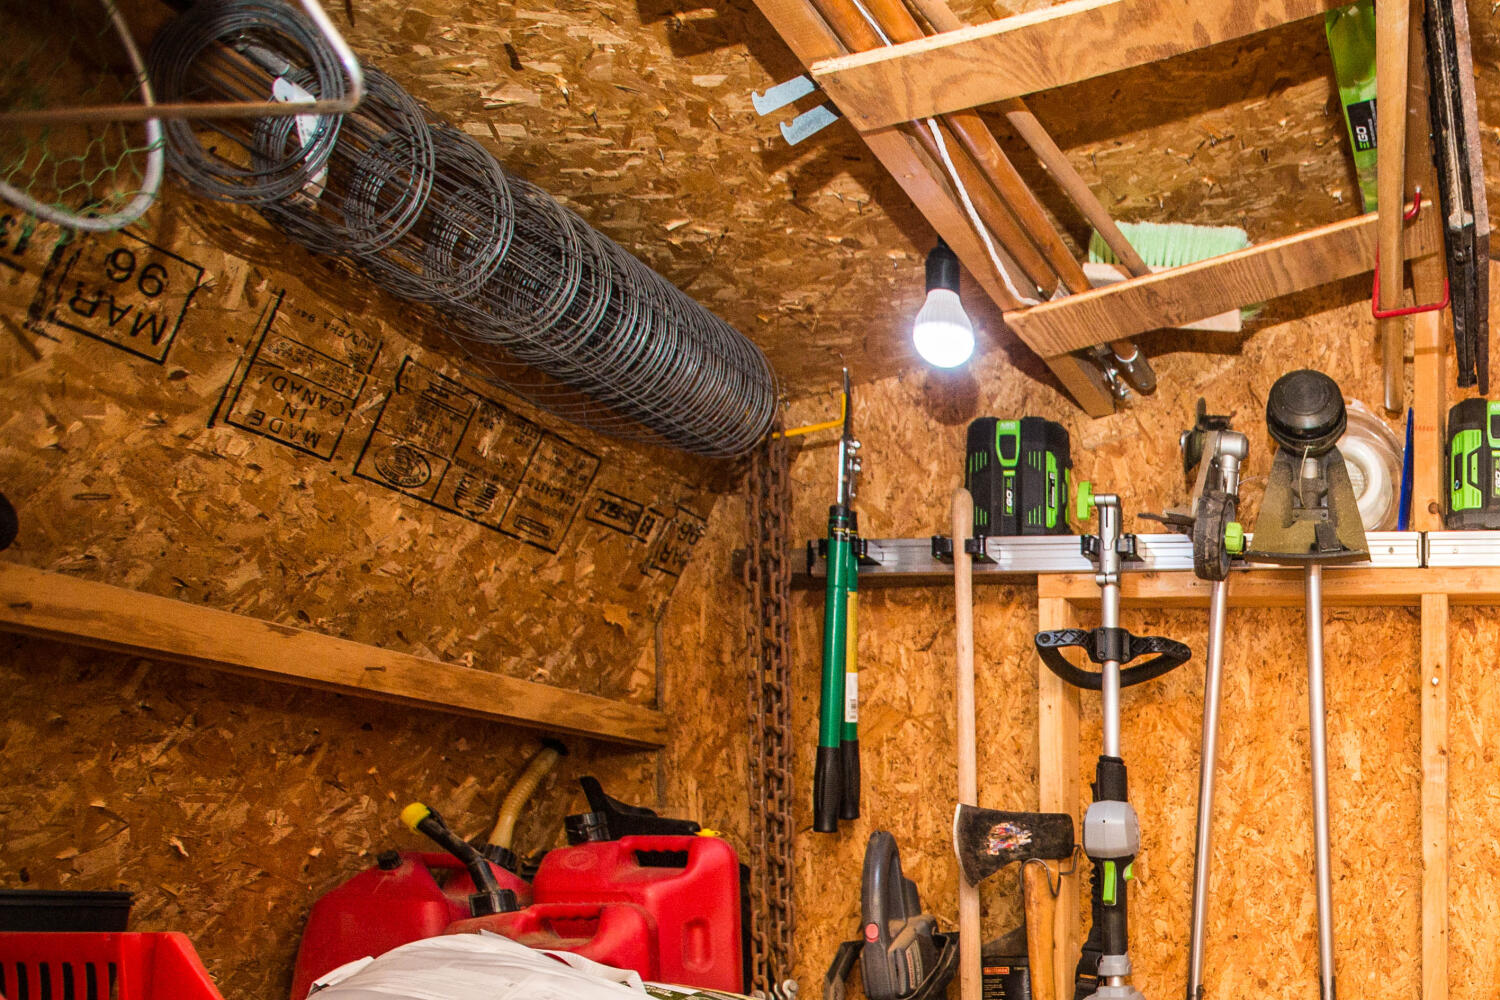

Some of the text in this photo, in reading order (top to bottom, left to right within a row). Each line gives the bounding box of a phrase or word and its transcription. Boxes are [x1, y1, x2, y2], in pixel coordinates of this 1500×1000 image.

[1356, 125, 1370, 149] EGO
[99, 242, 172, 301] 96
[64, 275, 171, 348] MAR
[247, 404, 323, 453] MADE
[278, 398, 308, 424] IN
